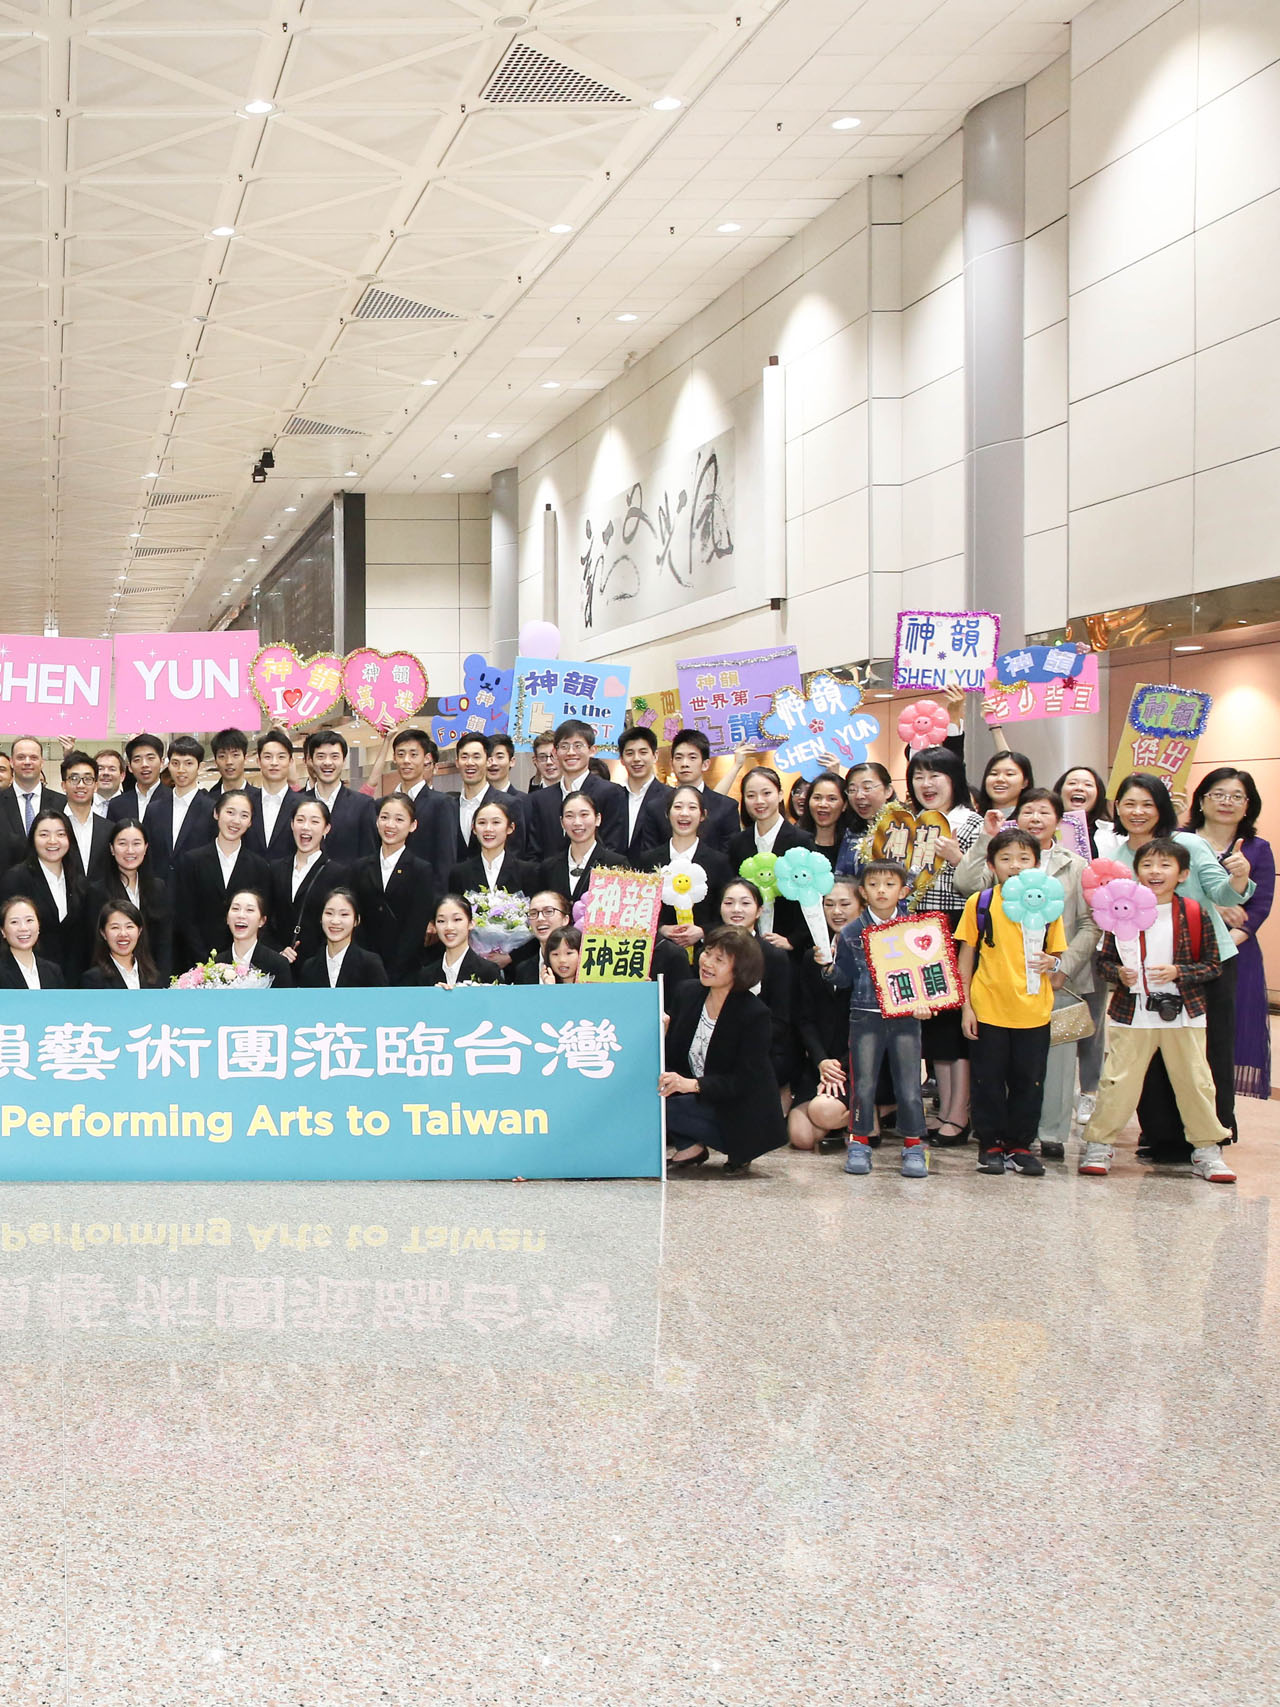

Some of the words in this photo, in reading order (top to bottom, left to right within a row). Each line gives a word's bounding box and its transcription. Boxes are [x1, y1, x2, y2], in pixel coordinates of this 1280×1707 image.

[905, 617, 980, 656] 神韻
[133, 658, 239, 701] YUN
[260, 658, 340, 696] 神韻
[362, 663, 410, 684] 神韻
[524, 669, 599, 701] 神韻
[696, 672, 741, 690] 神韻
[898, 668, 946, 687] SHEN
[272, 687, 287, 714] I
[297, 691, 320, 716] U
[563, 703, 577, 715] is
[581, 704, 612, 718] the
[689, 690, 774, 713] 世界第一
[777, 678, 846, 730] 神韻
[1142, 696, 1197, 729] 神韻
[775, 737, 825, 770] SHEN
[835, 718, 877, 745] YUN
[1132, 739, 1189, 773] 傑出
[587, 877, 656, 931] 神韻
[582, 938, 647, 978] 神韻
[882, 936, 903, 959] I
[1, 1103, 233, 1143] Performing
[247, 1104, 334, 1136] Arts
[347, 1106, 390, 1136] to
[403, 1102, 549, 1135] Taiwan
